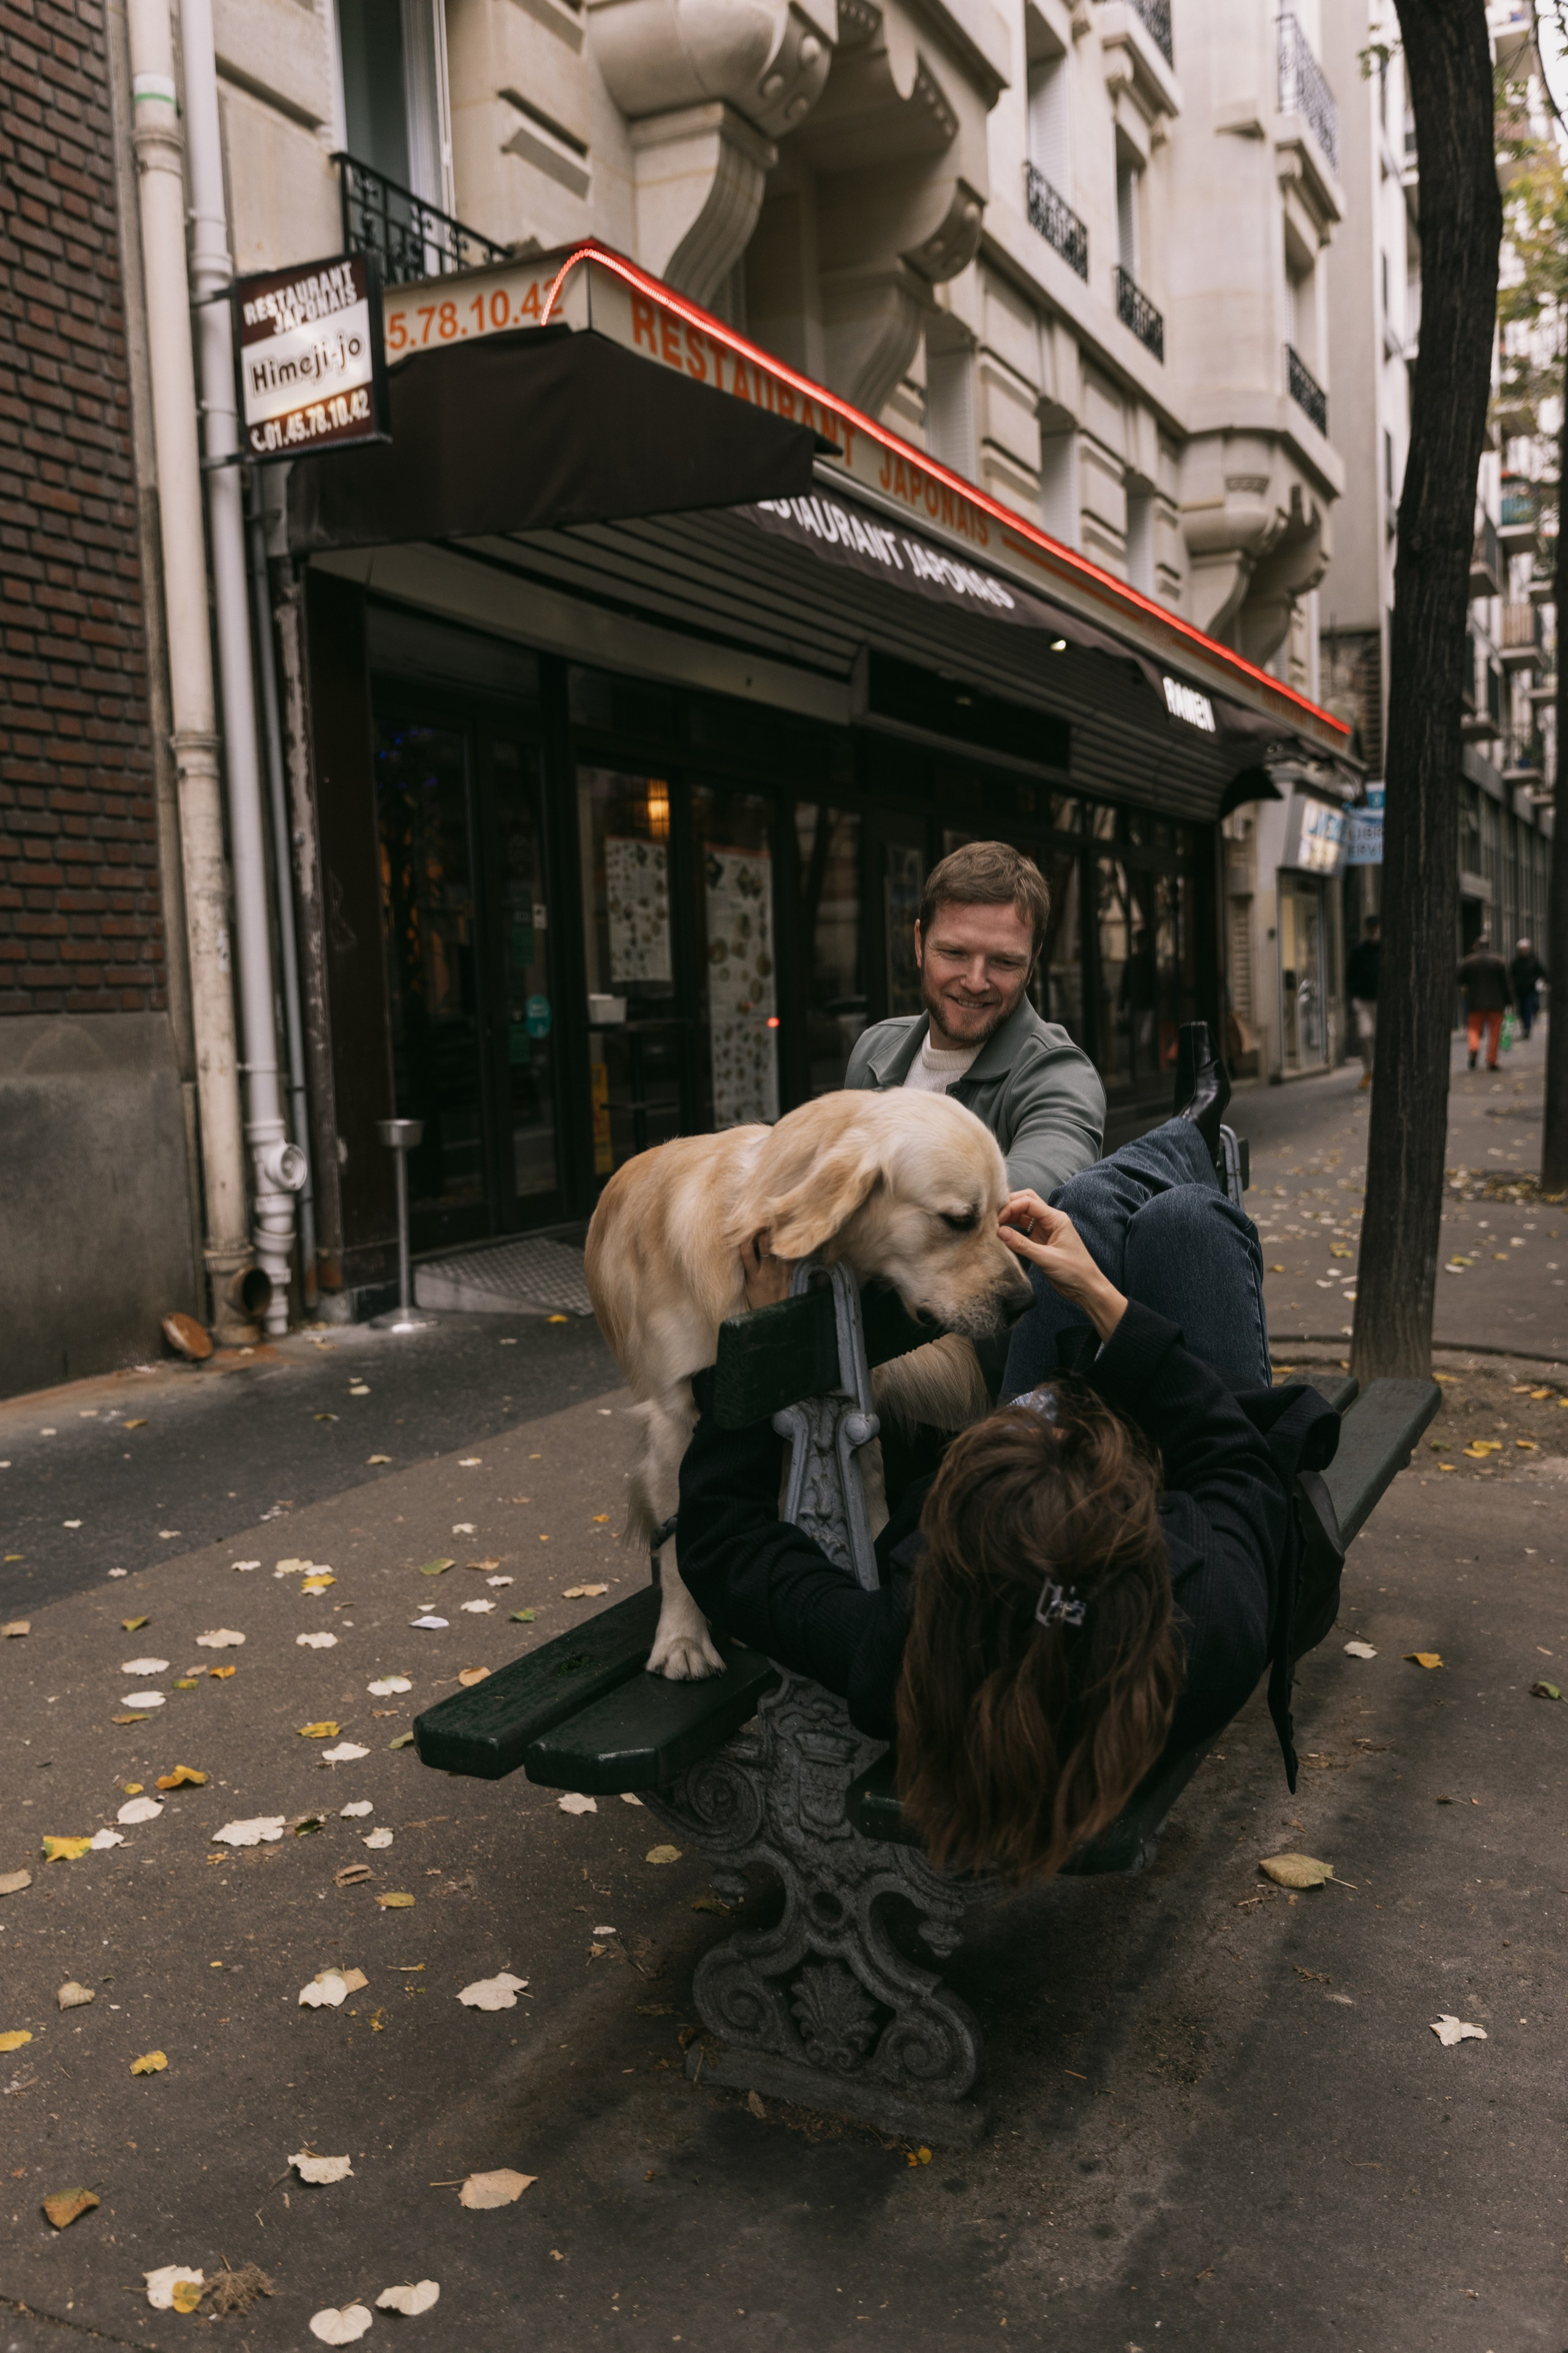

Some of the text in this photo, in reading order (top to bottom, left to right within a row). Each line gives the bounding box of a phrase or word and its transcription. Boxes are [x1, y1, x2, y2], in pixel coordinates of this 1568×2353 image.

[243, 261, 353, 326] RESTAURANT
[273, 282, 356, 334] JAPONAIS
[385, 278, 565, 350] 5.78.10.42
